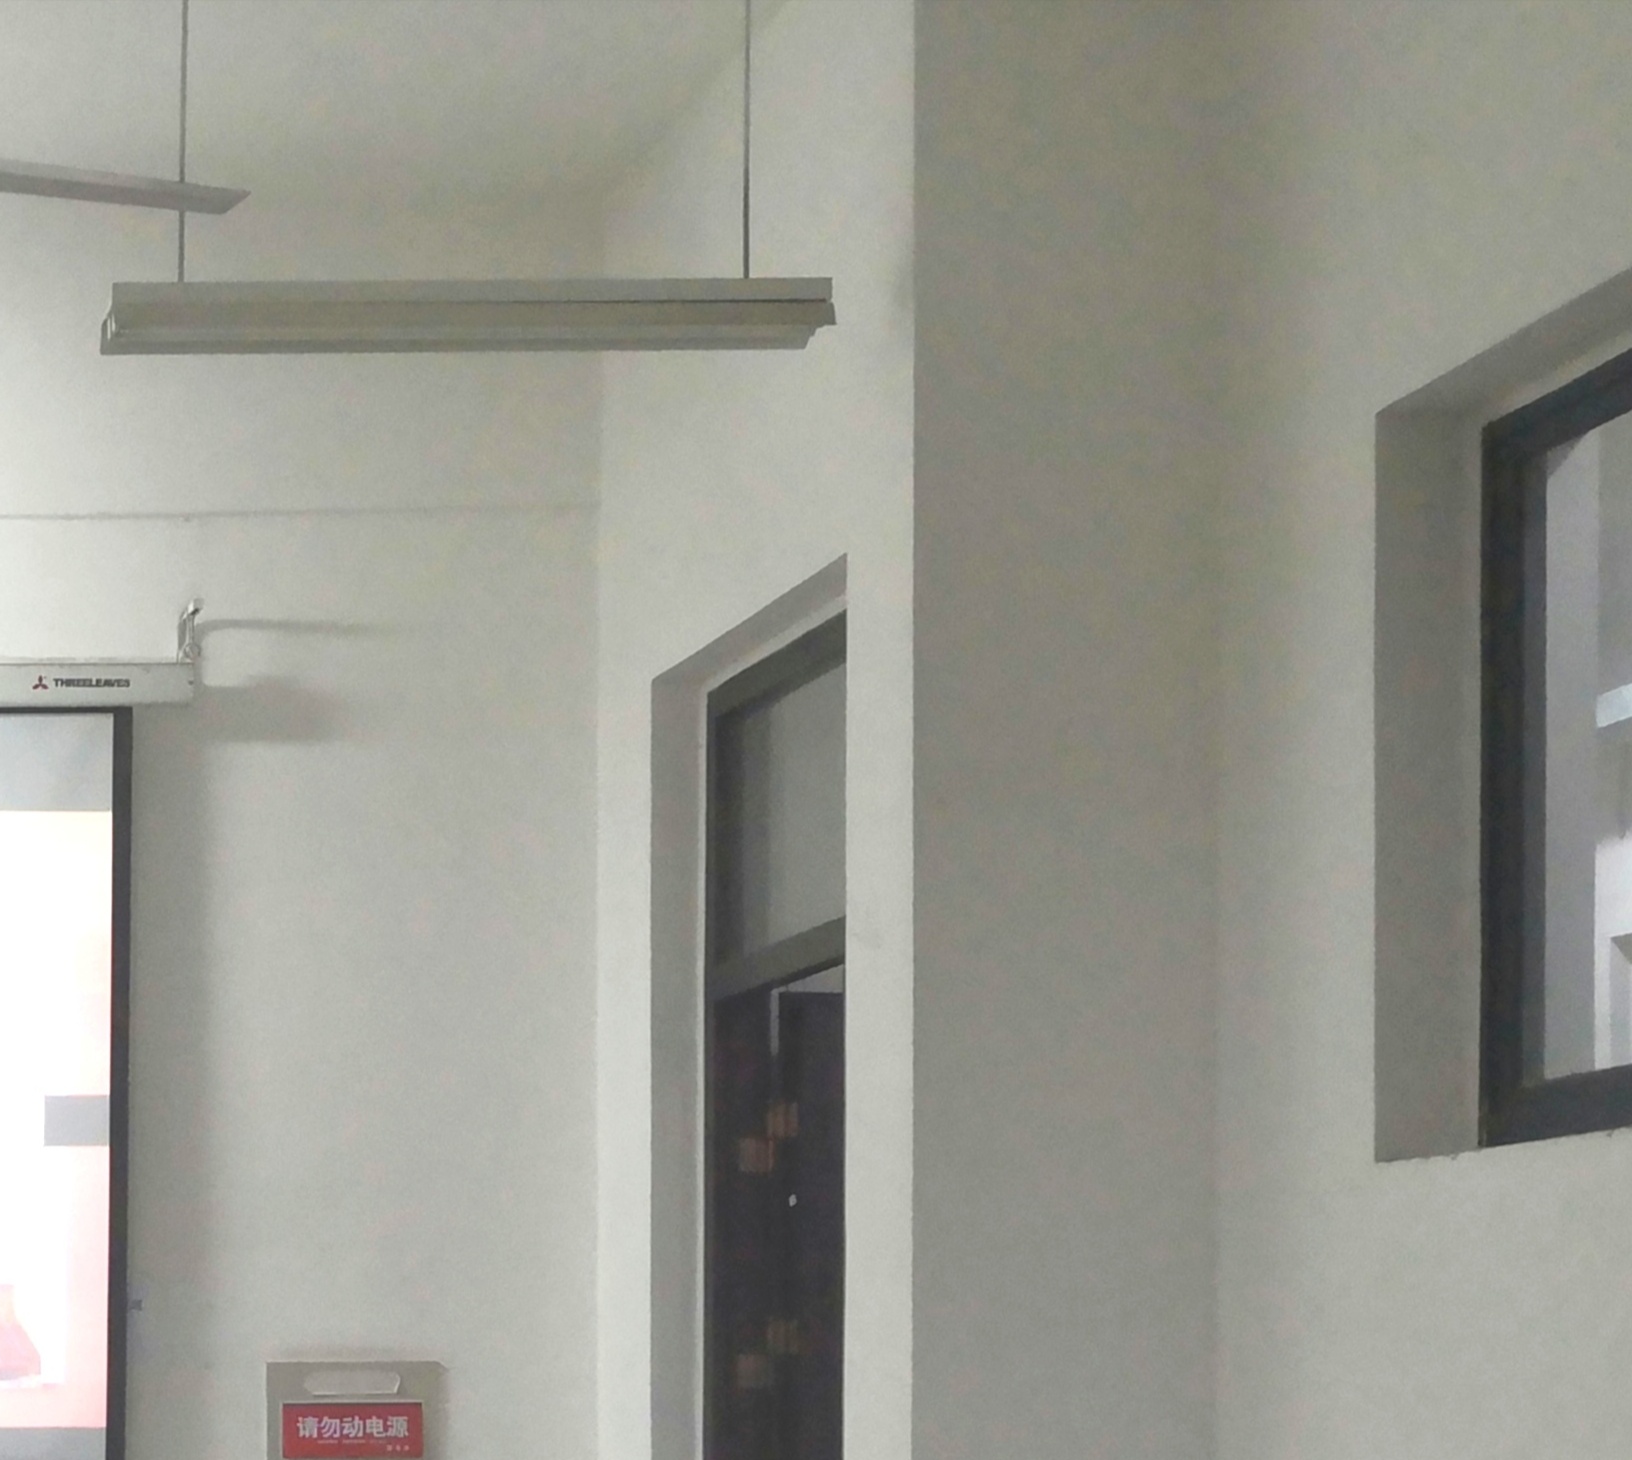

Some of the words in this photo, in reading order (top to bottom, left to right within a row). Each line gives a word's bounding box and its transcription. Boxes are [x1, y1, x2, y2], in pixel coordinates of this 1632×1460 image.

[296, 1415, 410, 1439] 请勿动电源
